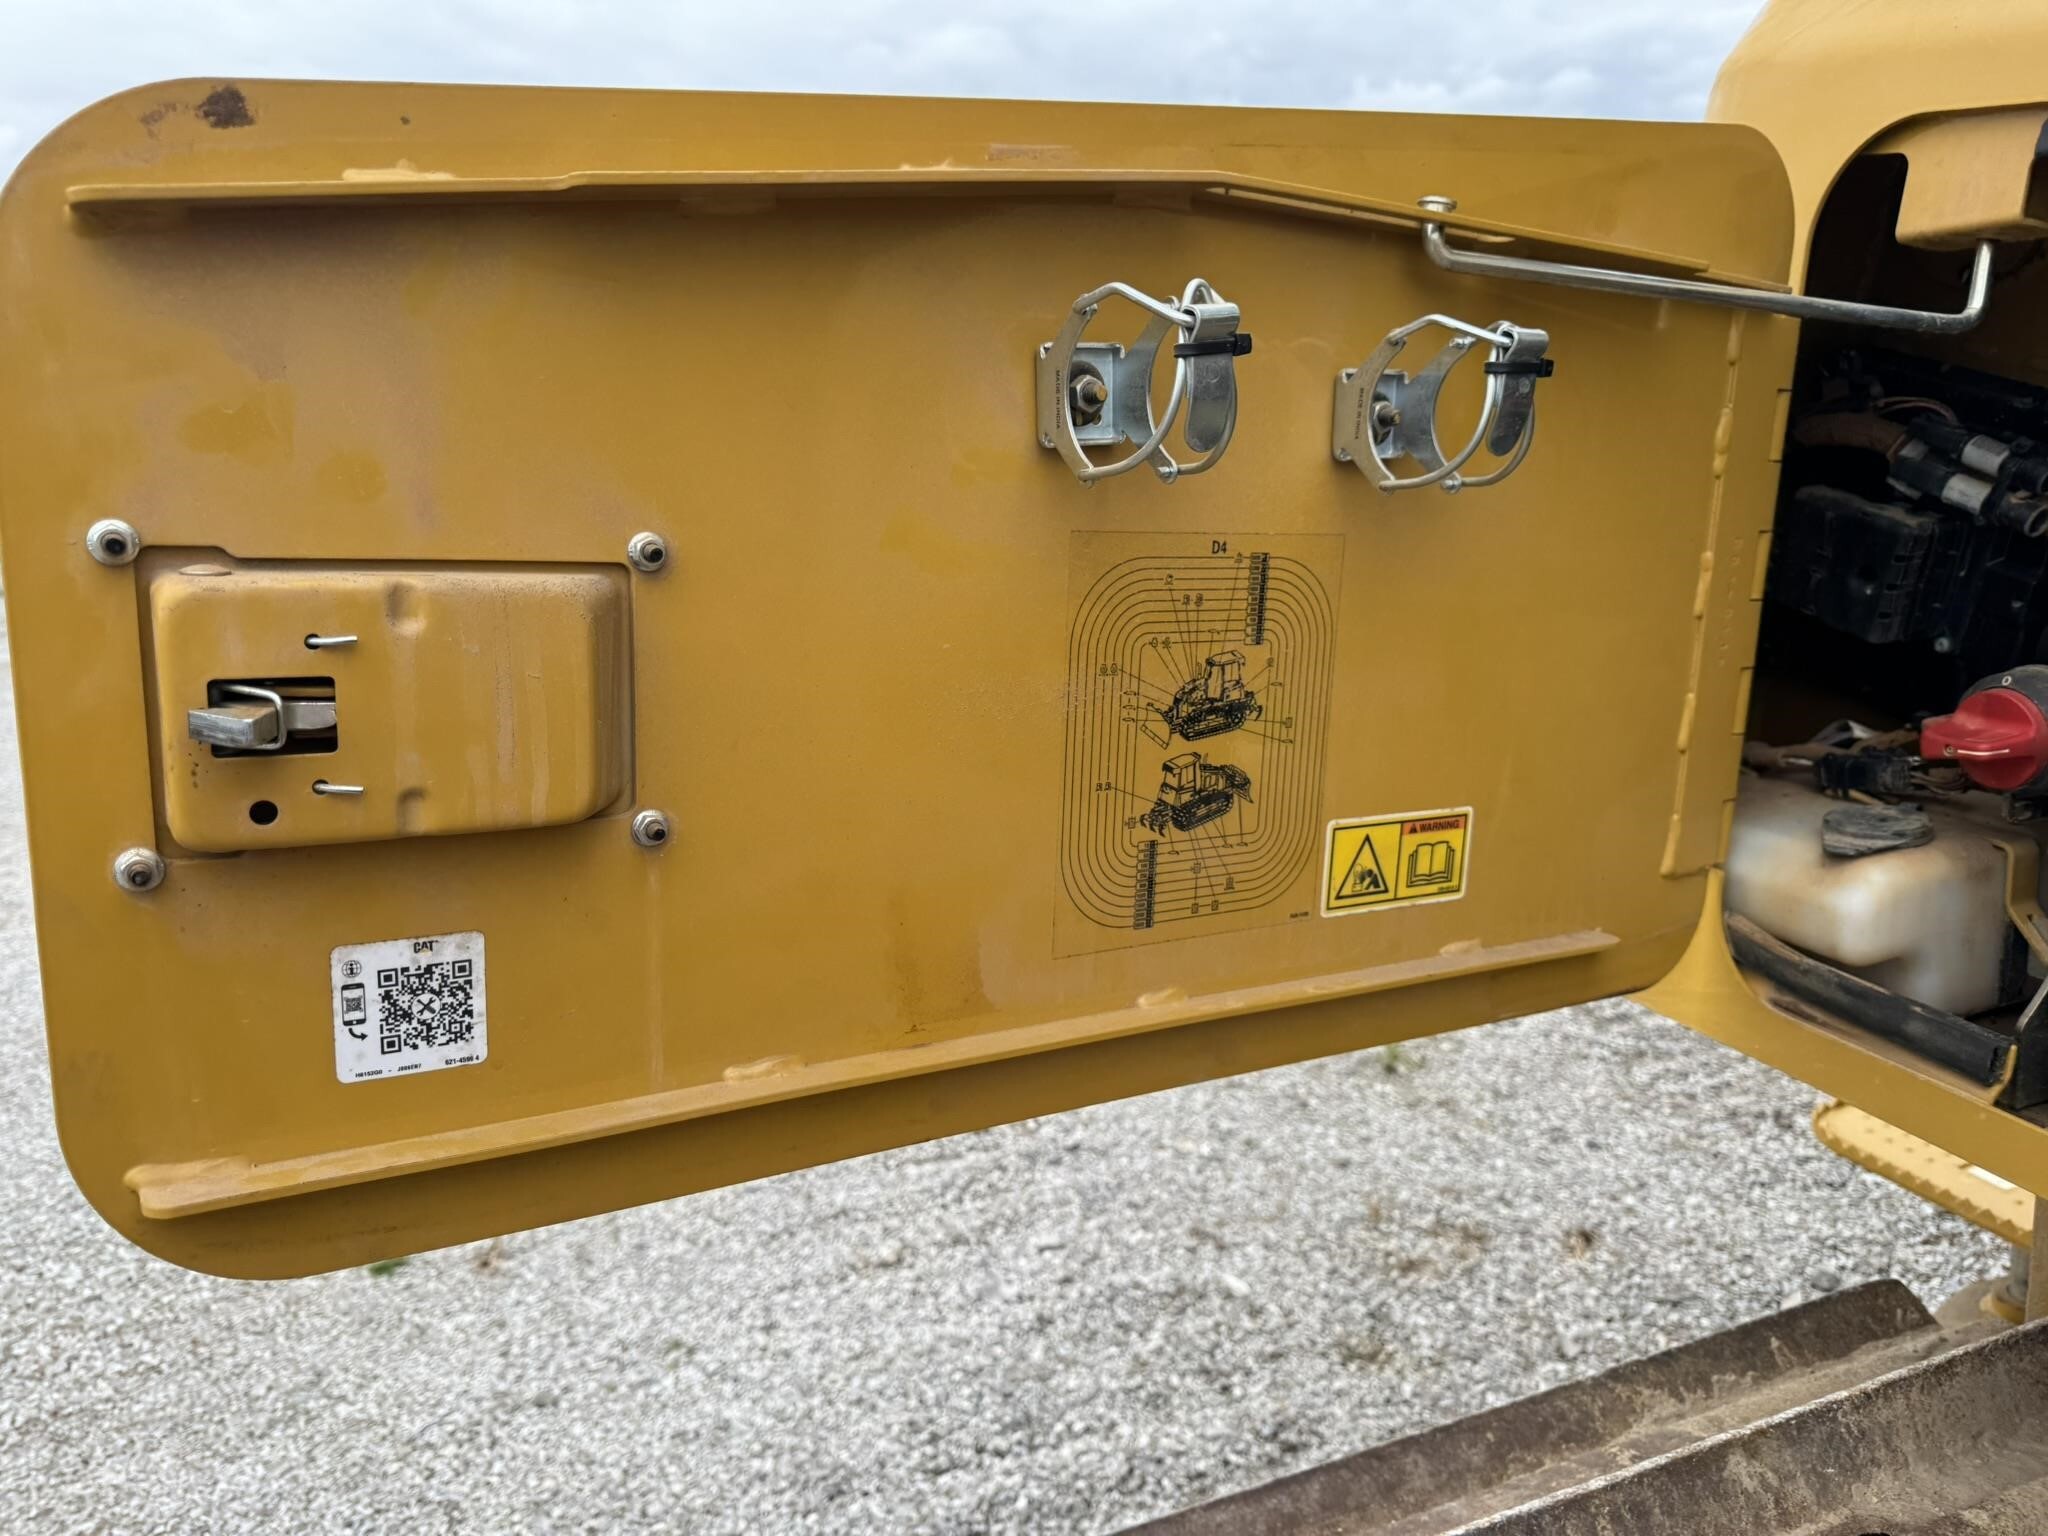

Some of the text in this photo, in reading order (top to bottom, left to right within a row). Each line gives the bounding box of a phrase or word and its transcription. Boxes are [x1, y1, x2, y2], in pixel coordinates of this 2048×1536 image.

[1212, 540, 1227, 554] D4
[1419, 819, 1459, 833] WARNING
[413, 940, 434, 954] CAT
